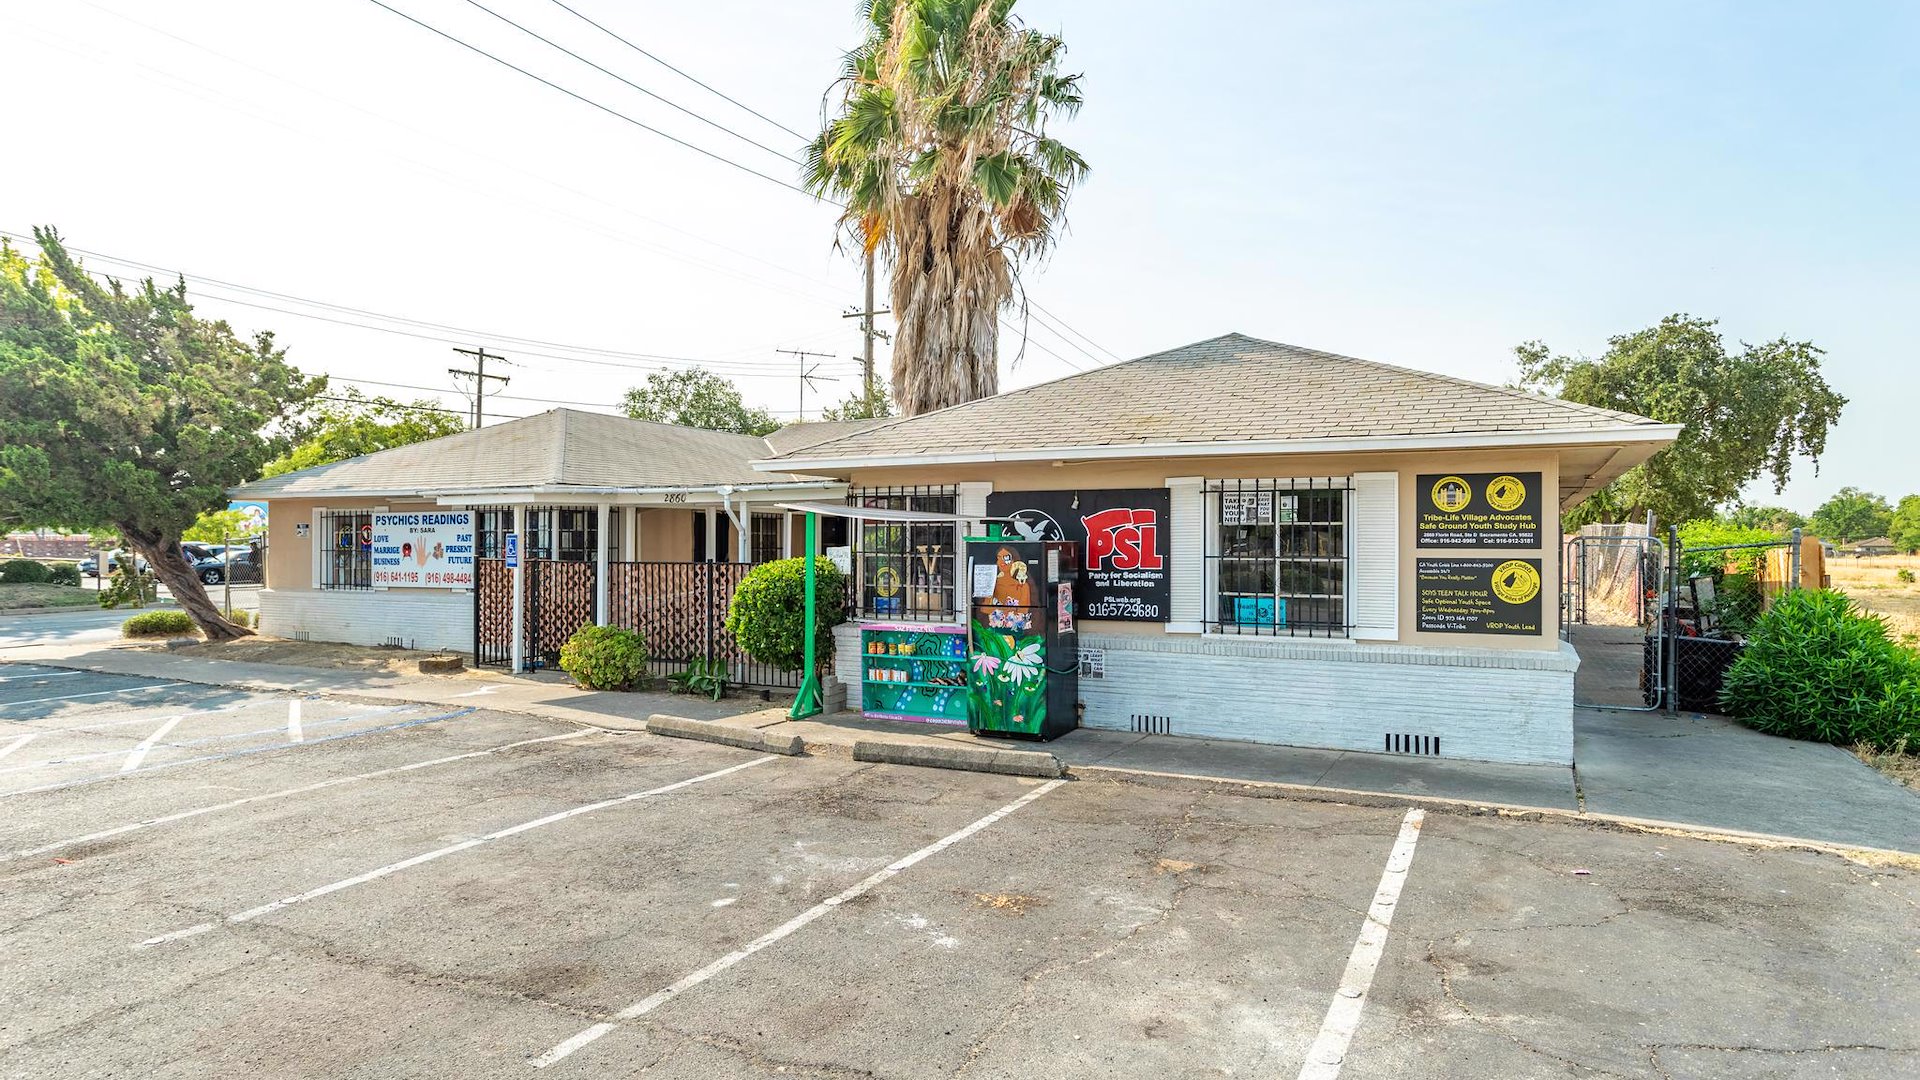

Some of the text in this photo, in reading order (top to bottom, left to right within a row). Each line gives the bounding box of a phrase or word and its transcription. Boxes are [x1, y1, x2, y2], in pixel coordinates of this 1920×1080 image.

[664, 494, 687, 503] 2860
[376, 514, 469, 525] PSYCHICS READINGS
[1461, 514, 1487, 522] Village
[1494, 522, 1518, 530] Study
[1081, 508, 1162, 570] PSL
[1498, 563, 1513, 572] VROP
[374, 572, 418, 584] (916) 641-1195
[425, 572, 440, 585] (916)
